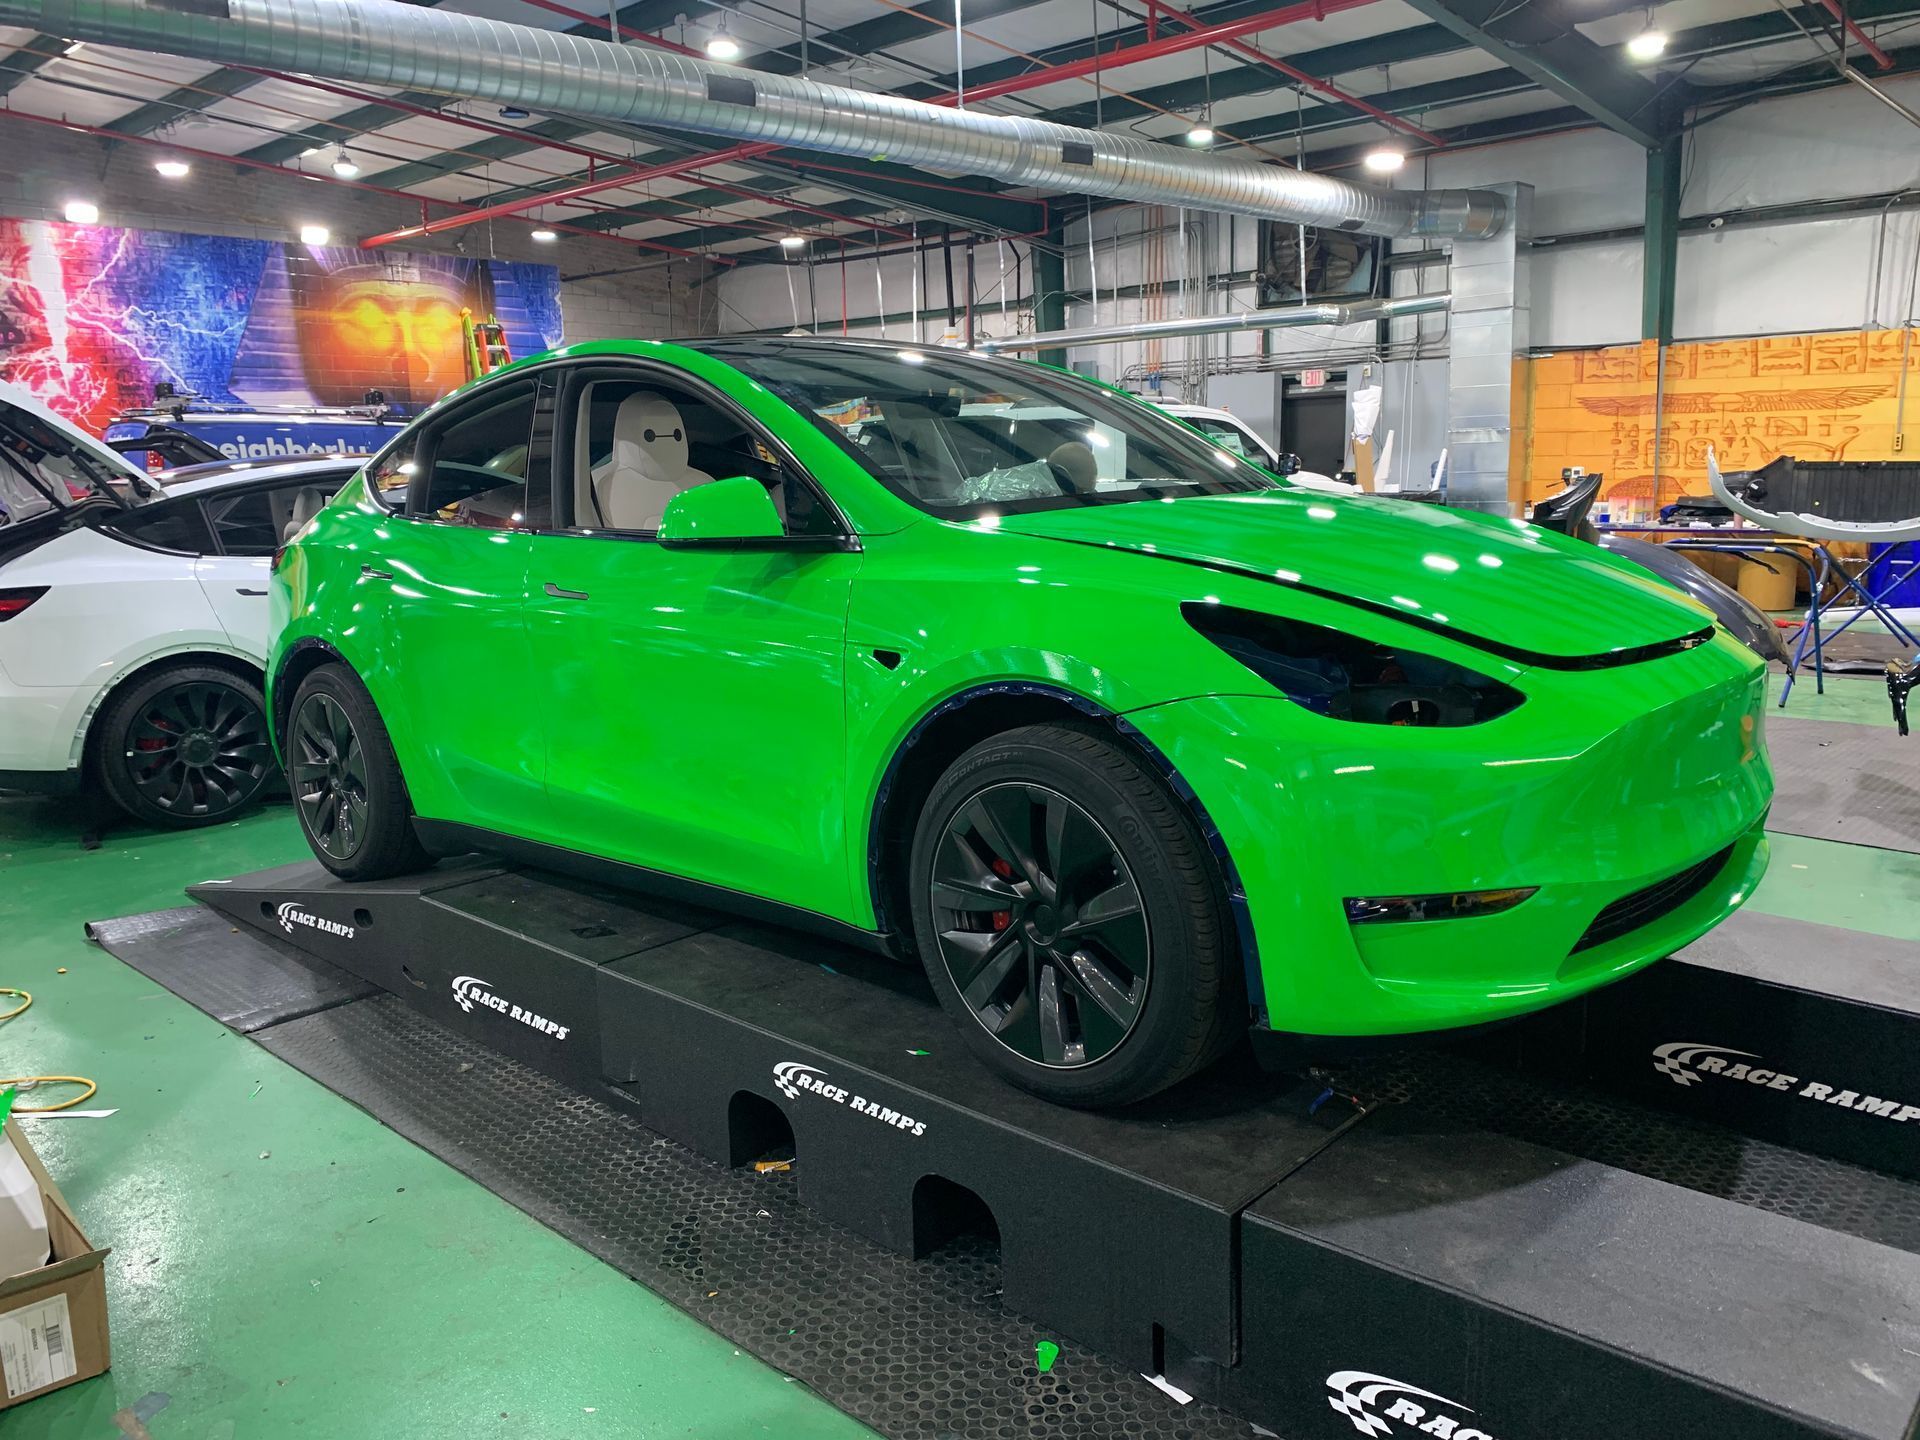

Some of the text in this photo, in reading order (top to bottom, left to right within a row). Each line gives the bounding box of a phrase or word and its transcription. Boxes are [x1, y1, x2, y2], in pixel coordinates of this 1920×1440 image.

[1305, 370, 1322, 385] EXIT
[203, 435, 367, 459] eighborl
[290, 909, 355, 939] RACE RAMPS
[469, 986, 569, 1040] RACE RAMPS
[796, 1073, 927, 1136] RACE RAMPS
[1696, 1056, 1920, 1122] RACE RAMP
